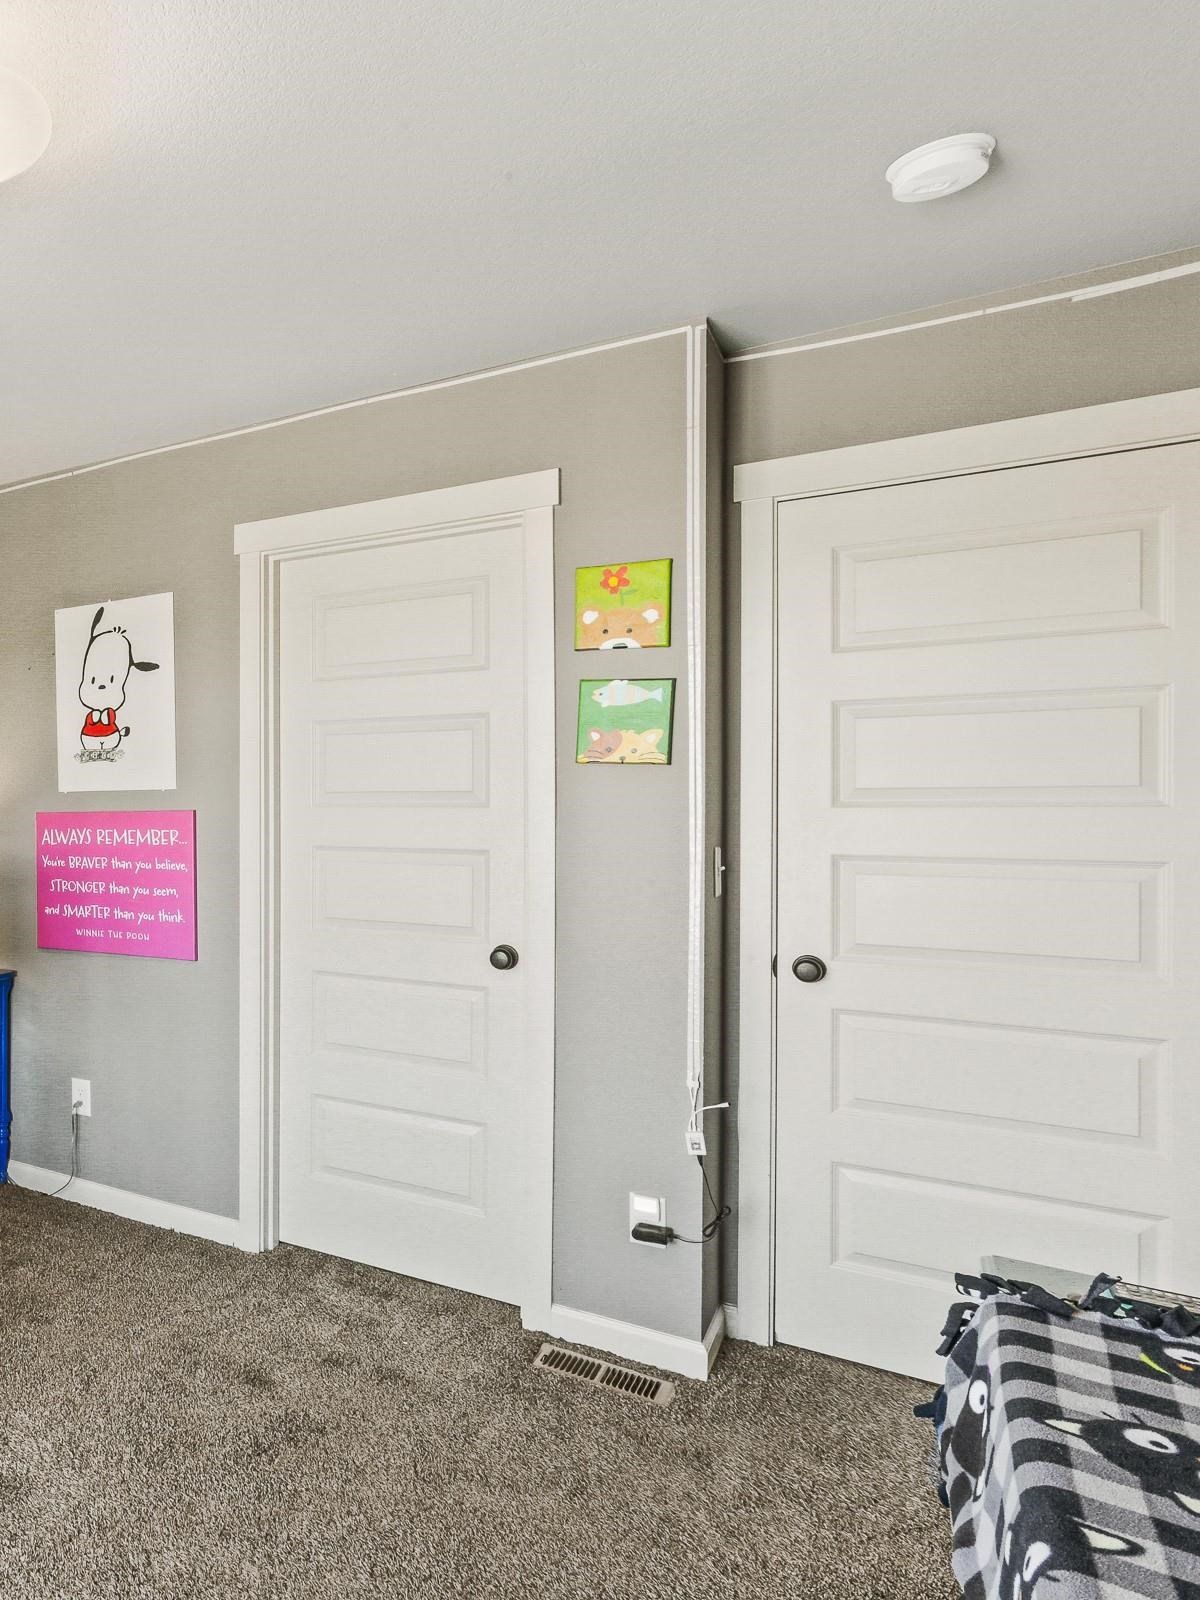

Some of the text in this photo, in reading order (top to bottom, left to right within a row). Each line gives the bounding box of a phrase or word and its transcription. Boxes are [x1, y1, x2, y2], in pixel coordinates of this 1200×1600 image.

[42, 828, 92, 846] ALWAYS
[69, 856, 108, 869] BRAVER
[111, 857, 131, 869] than
[135, 861, 151, 874] you
[155, 859, 188, 872] believe,
[50, 879, 179, 899] STRONGER than you seem,
[44, 904, 59, 915] and
[63, 904, 110, 919] SMARTER
[114, 908, 134, 920] than
[138, 911, 154, 924] you
[76, 928, 149, 940] WINNIE THE POOH
